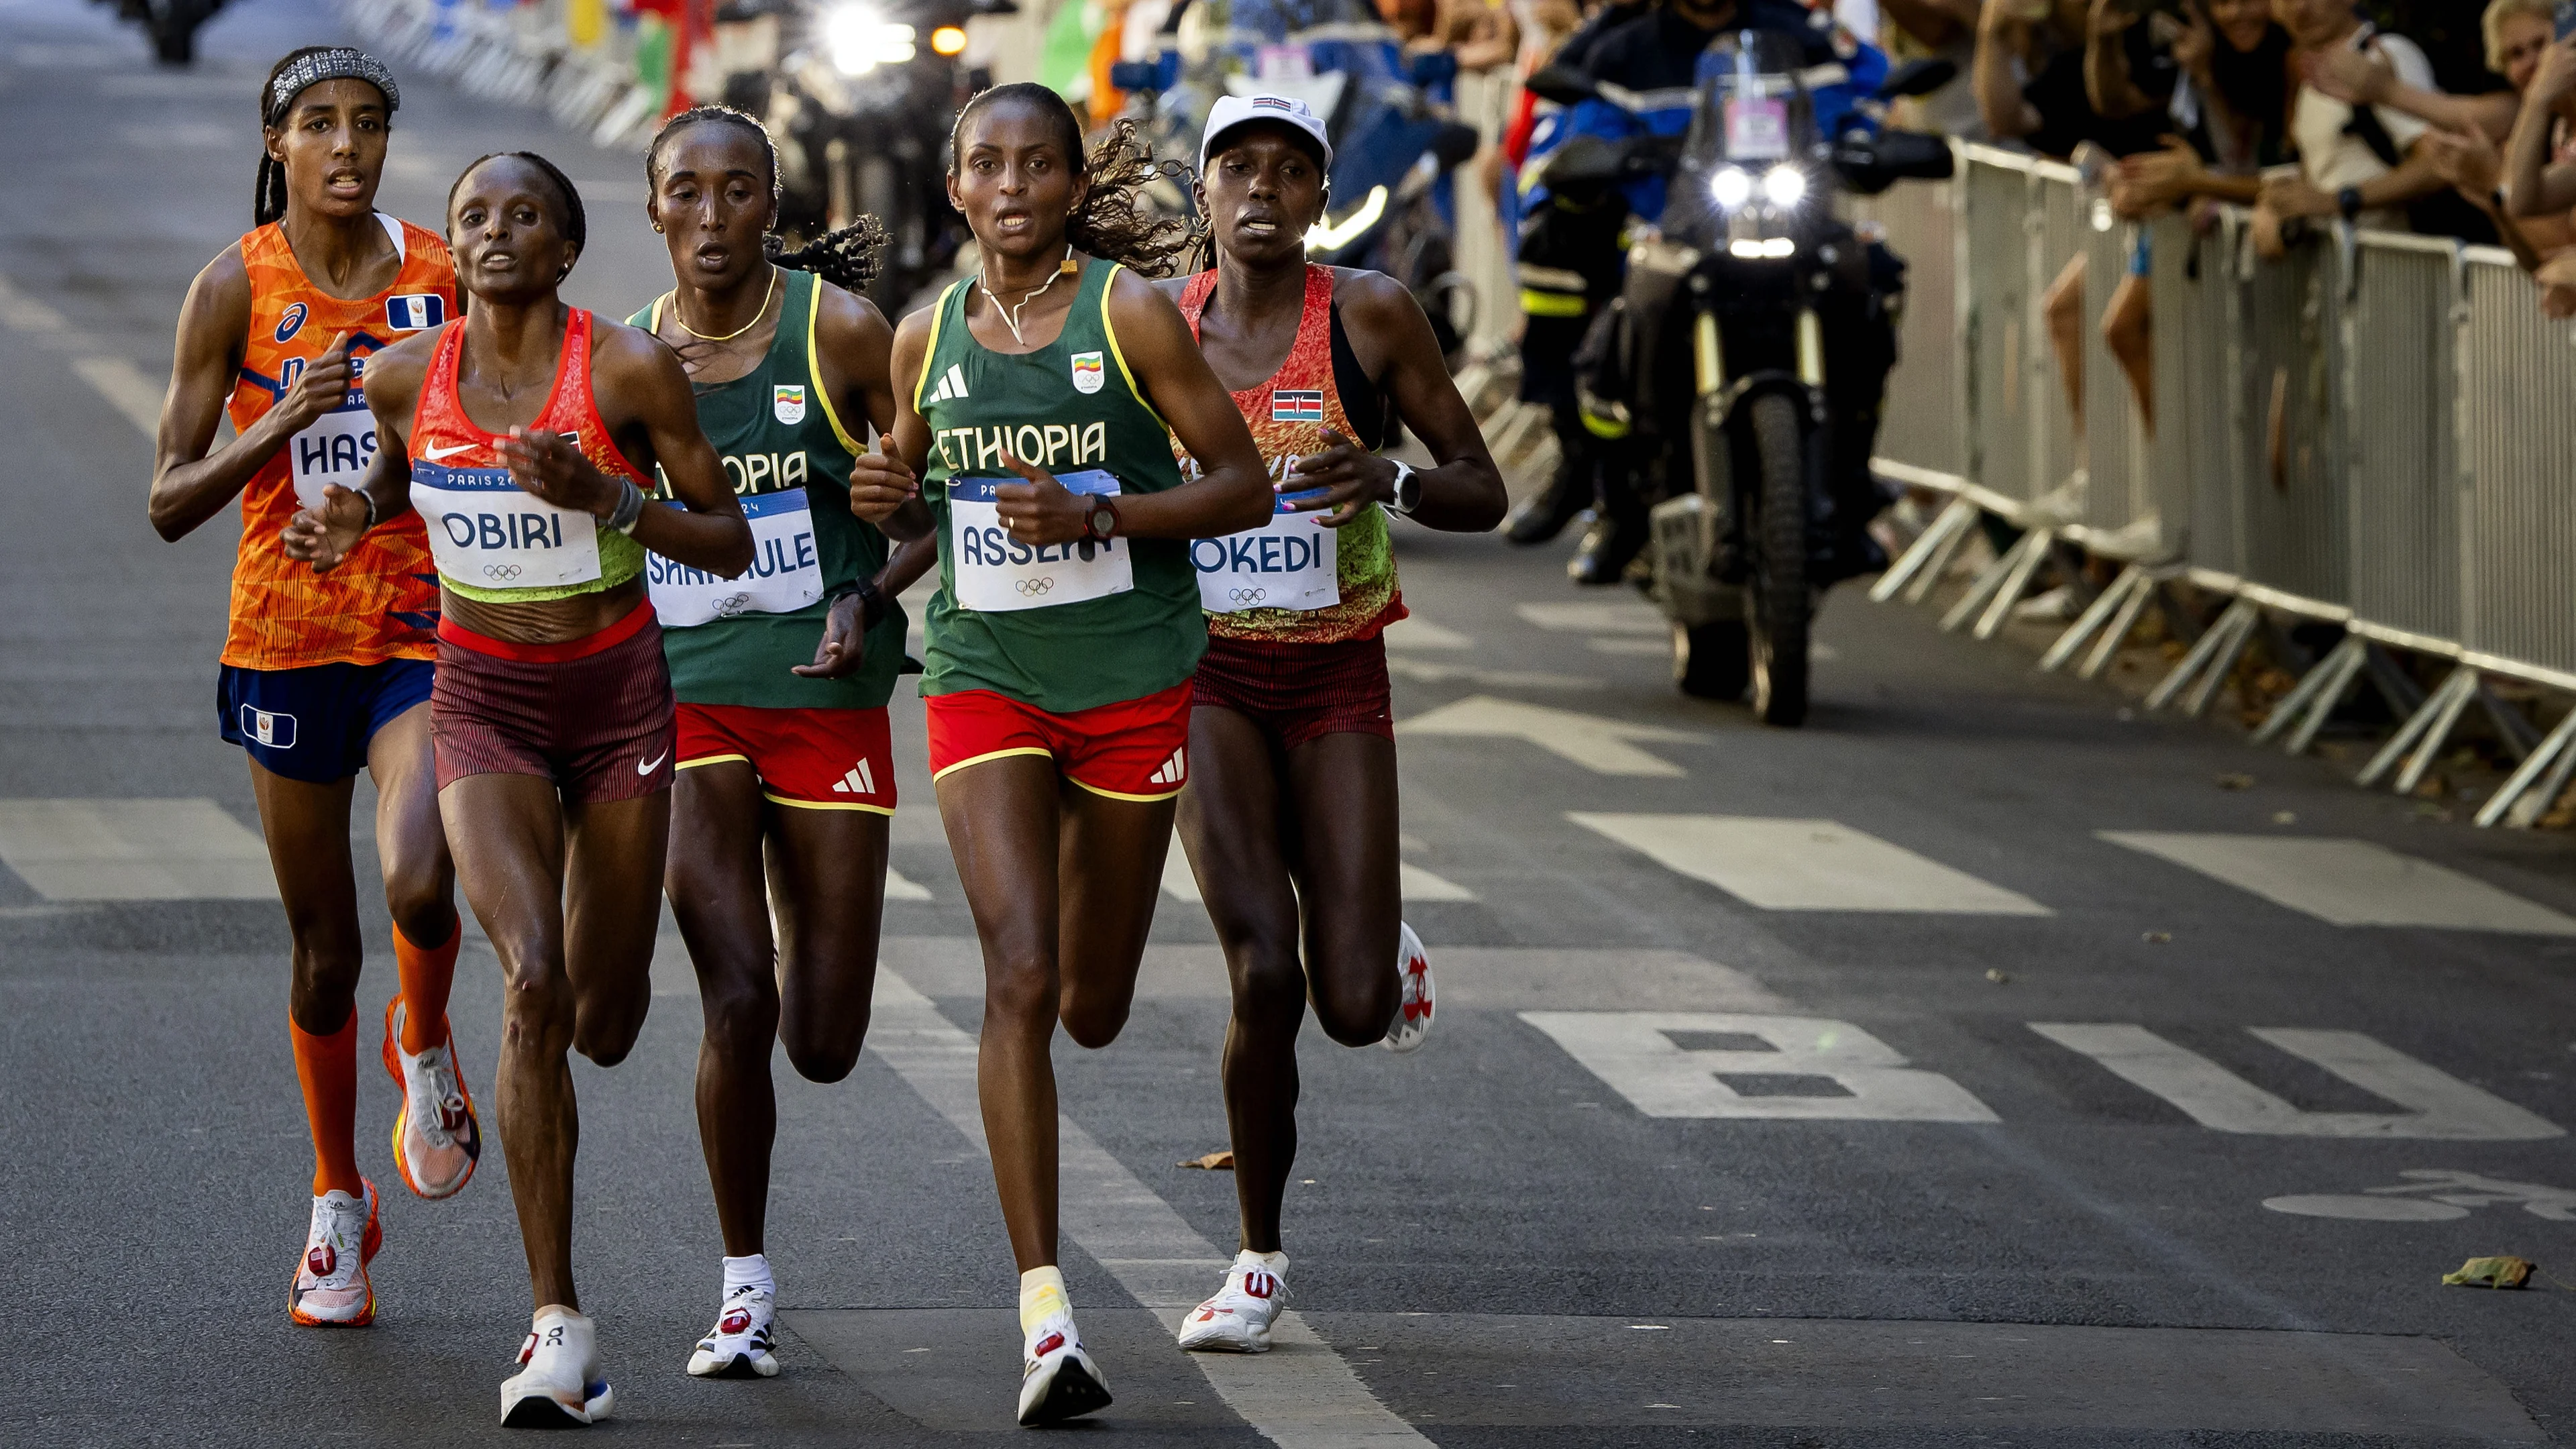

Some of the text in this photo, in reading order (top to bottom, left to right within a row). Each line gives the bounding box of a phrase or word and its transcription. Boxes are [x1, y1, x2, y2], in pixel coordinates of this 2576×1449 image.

[300, 431, 378, 476] HAS
[937, 421, 1106, 470] ETHIOPIA
[447, 474, 492, 486] PARIS
[441, 513, 562, 550] OBIRI
[1190, 533, 1321, 573] OKEDI
